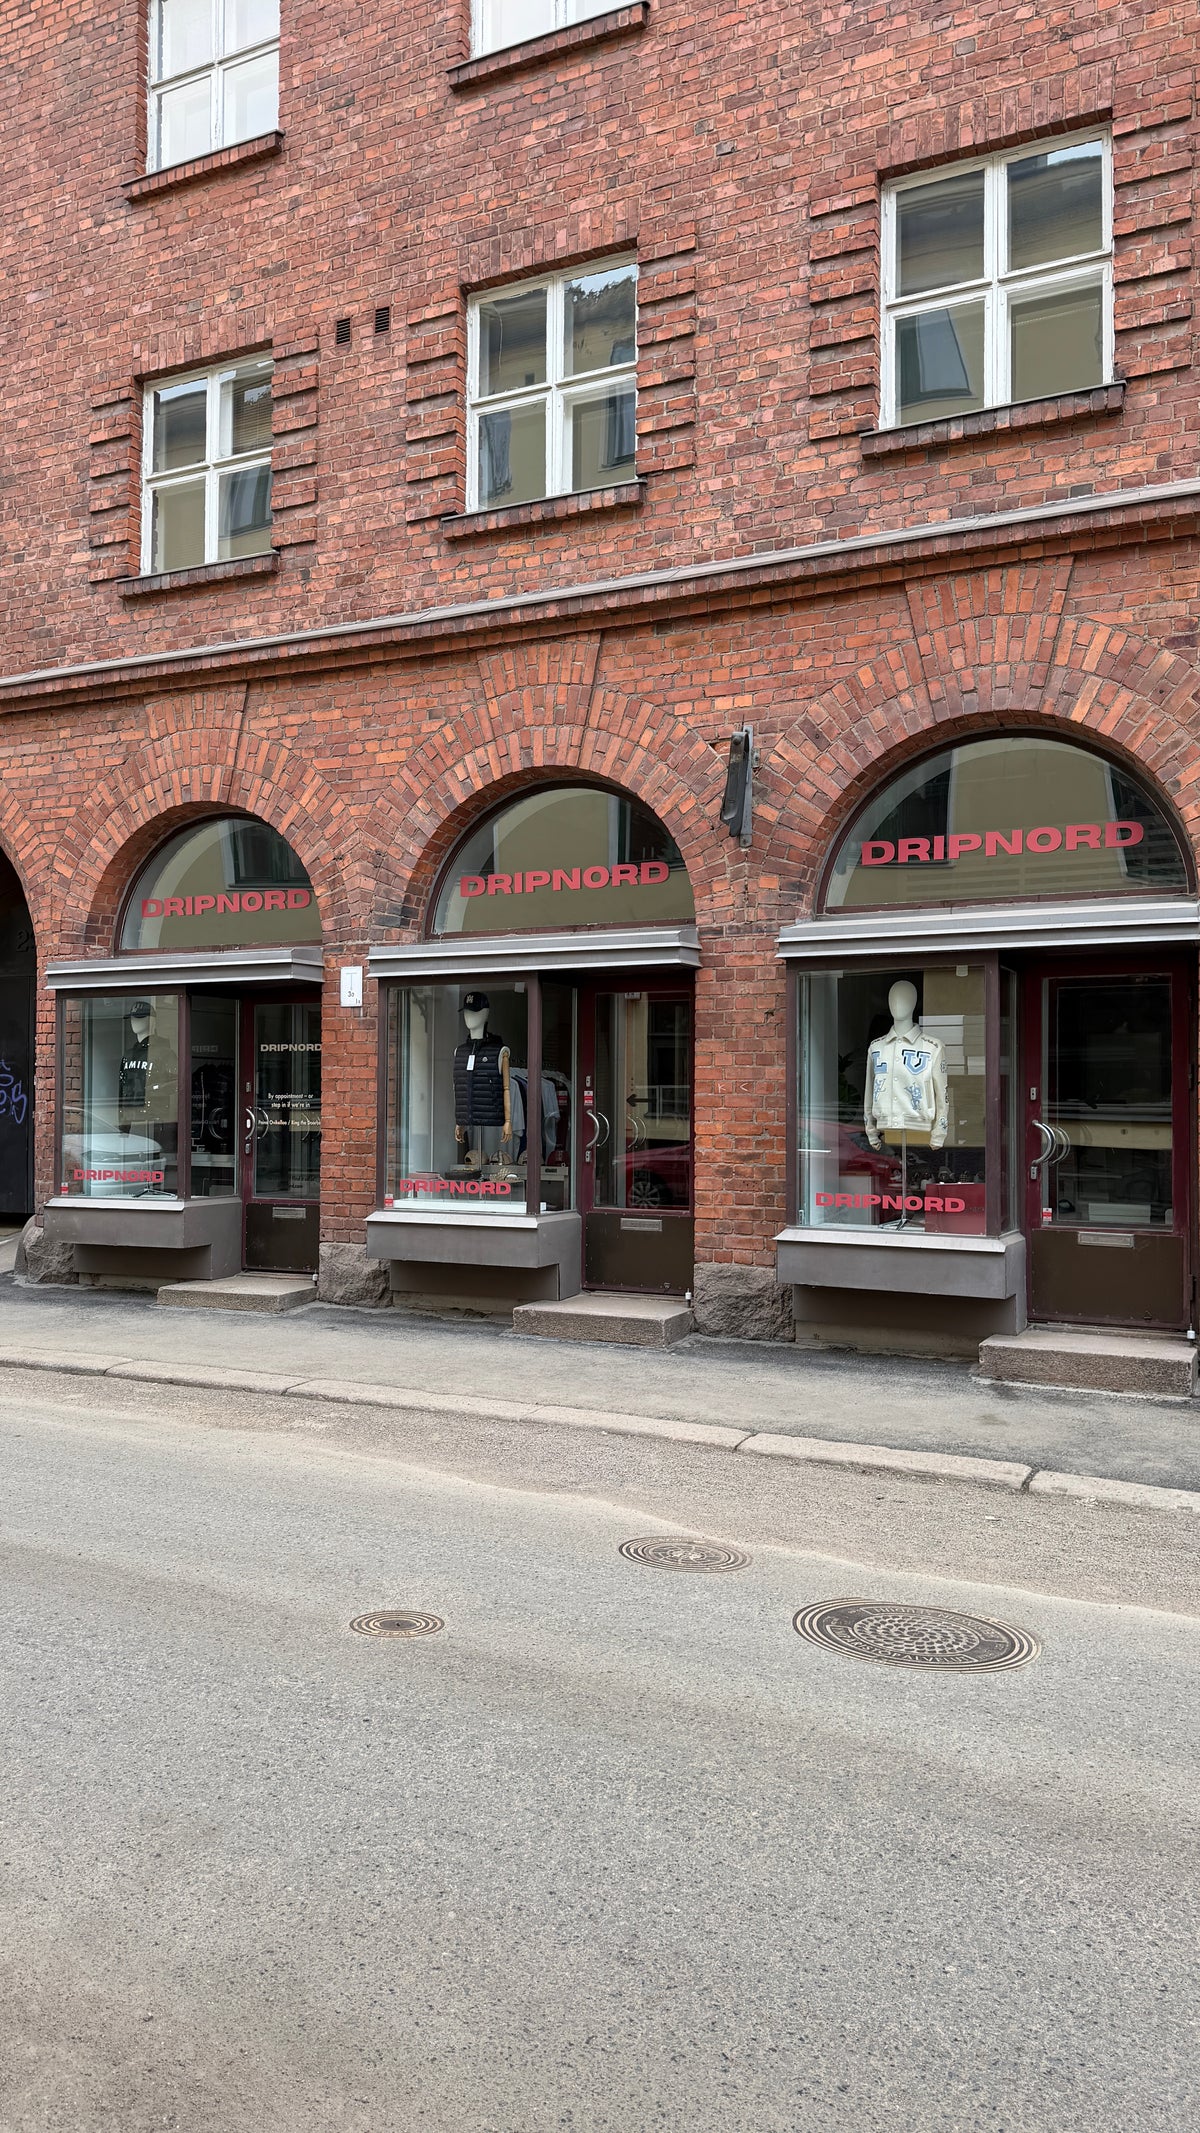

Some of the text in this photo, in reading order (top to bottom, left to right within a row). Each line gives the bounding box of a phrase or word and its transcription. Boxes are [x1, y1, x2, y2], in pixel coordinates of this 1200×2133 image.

[861, 821, 1144, 866] DRIPNORD
[460, 861, 669, 898] DRIPNORD
[142, 889, 310, 918] DRIPNORD
[260, 1044, 321, 1052] DRIPNORD
[124, 1060, 153, 1071] AMIRI
[73, 1168, 164, 1183] DRIPNORD
[399, 1179, 511, 1195] DRIPNORD
[815, 1192, 966, 1213] DRIPNORD
